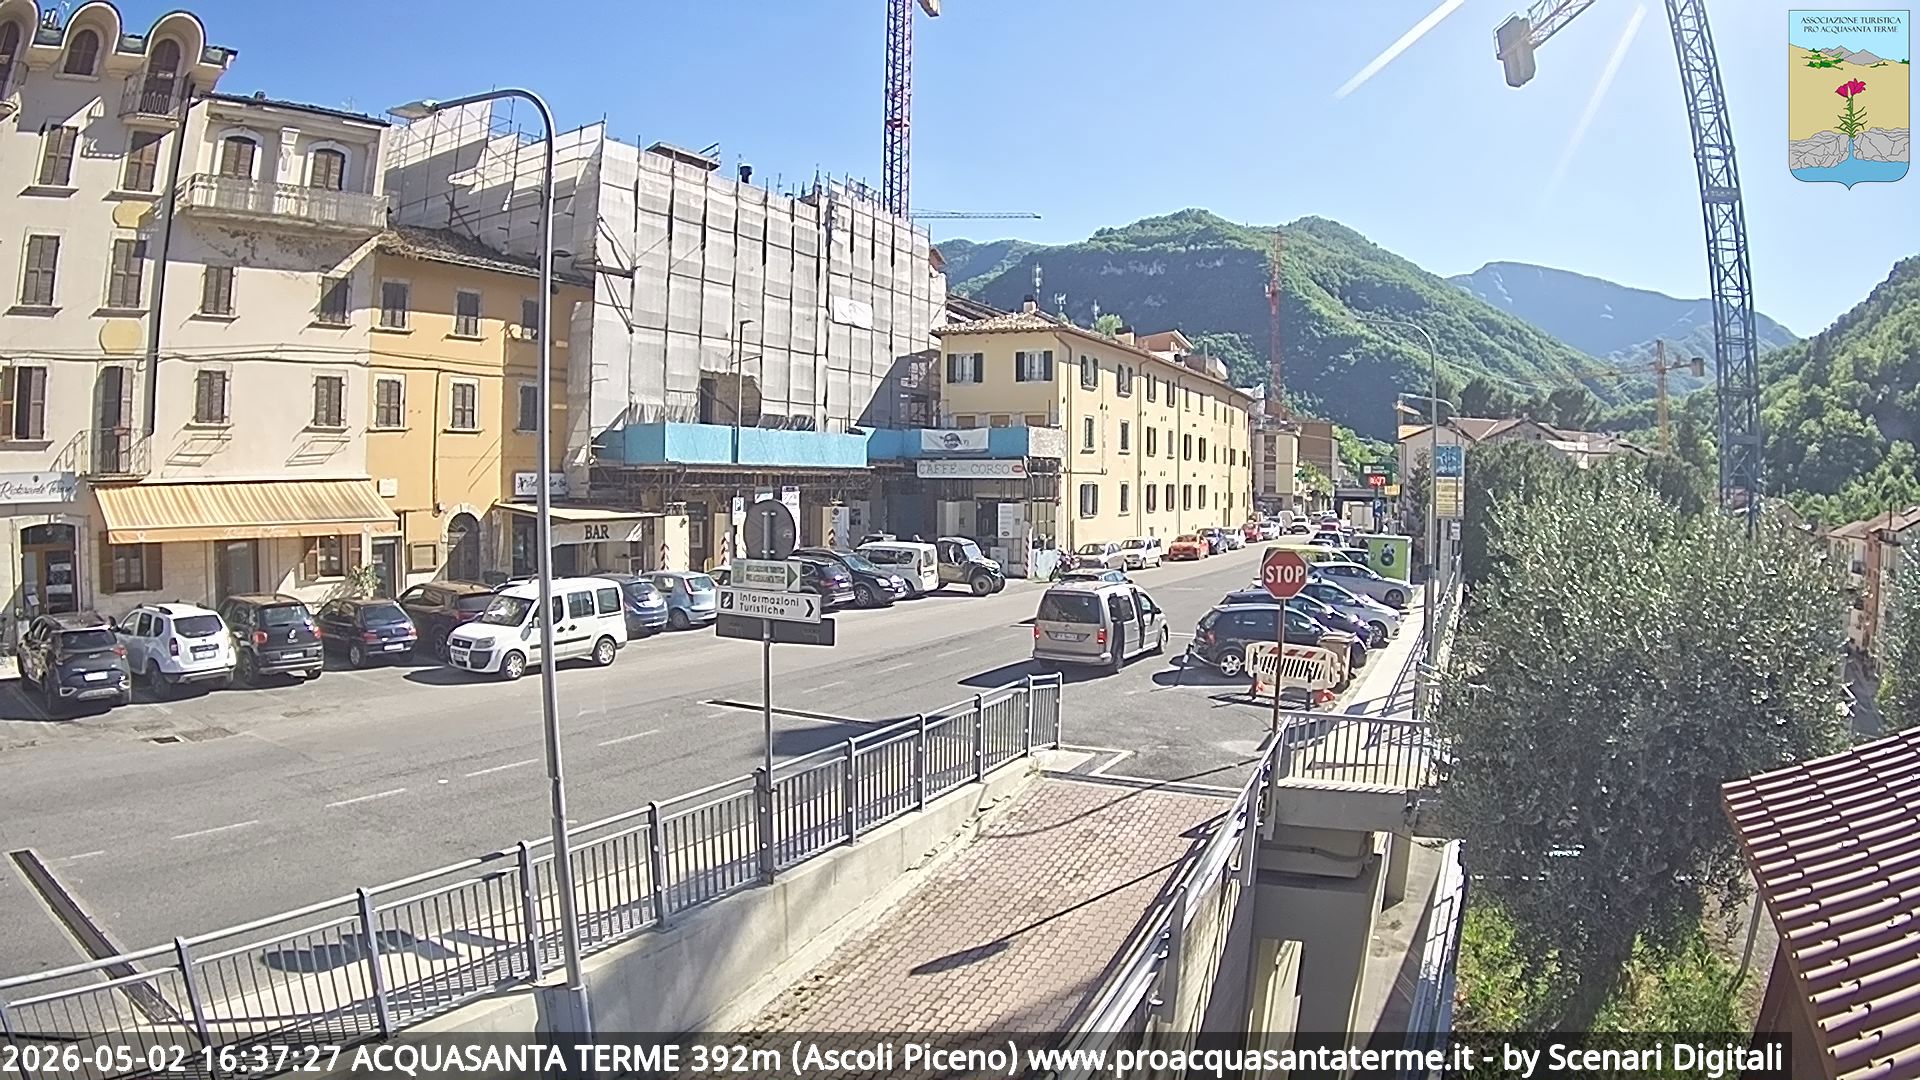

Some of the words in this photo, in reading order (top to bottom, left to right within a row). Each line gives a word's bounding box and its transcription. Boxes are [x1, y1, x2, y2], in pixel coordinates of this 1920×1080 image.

[970, 463, 1010, 475] CORSO
[584, 524, 610, 540] BAR
[1265, 564, 1305, 584] STOP
[739, 592, 799, 607] Informazioni
[739, 602, 785, 616] Turistiche
